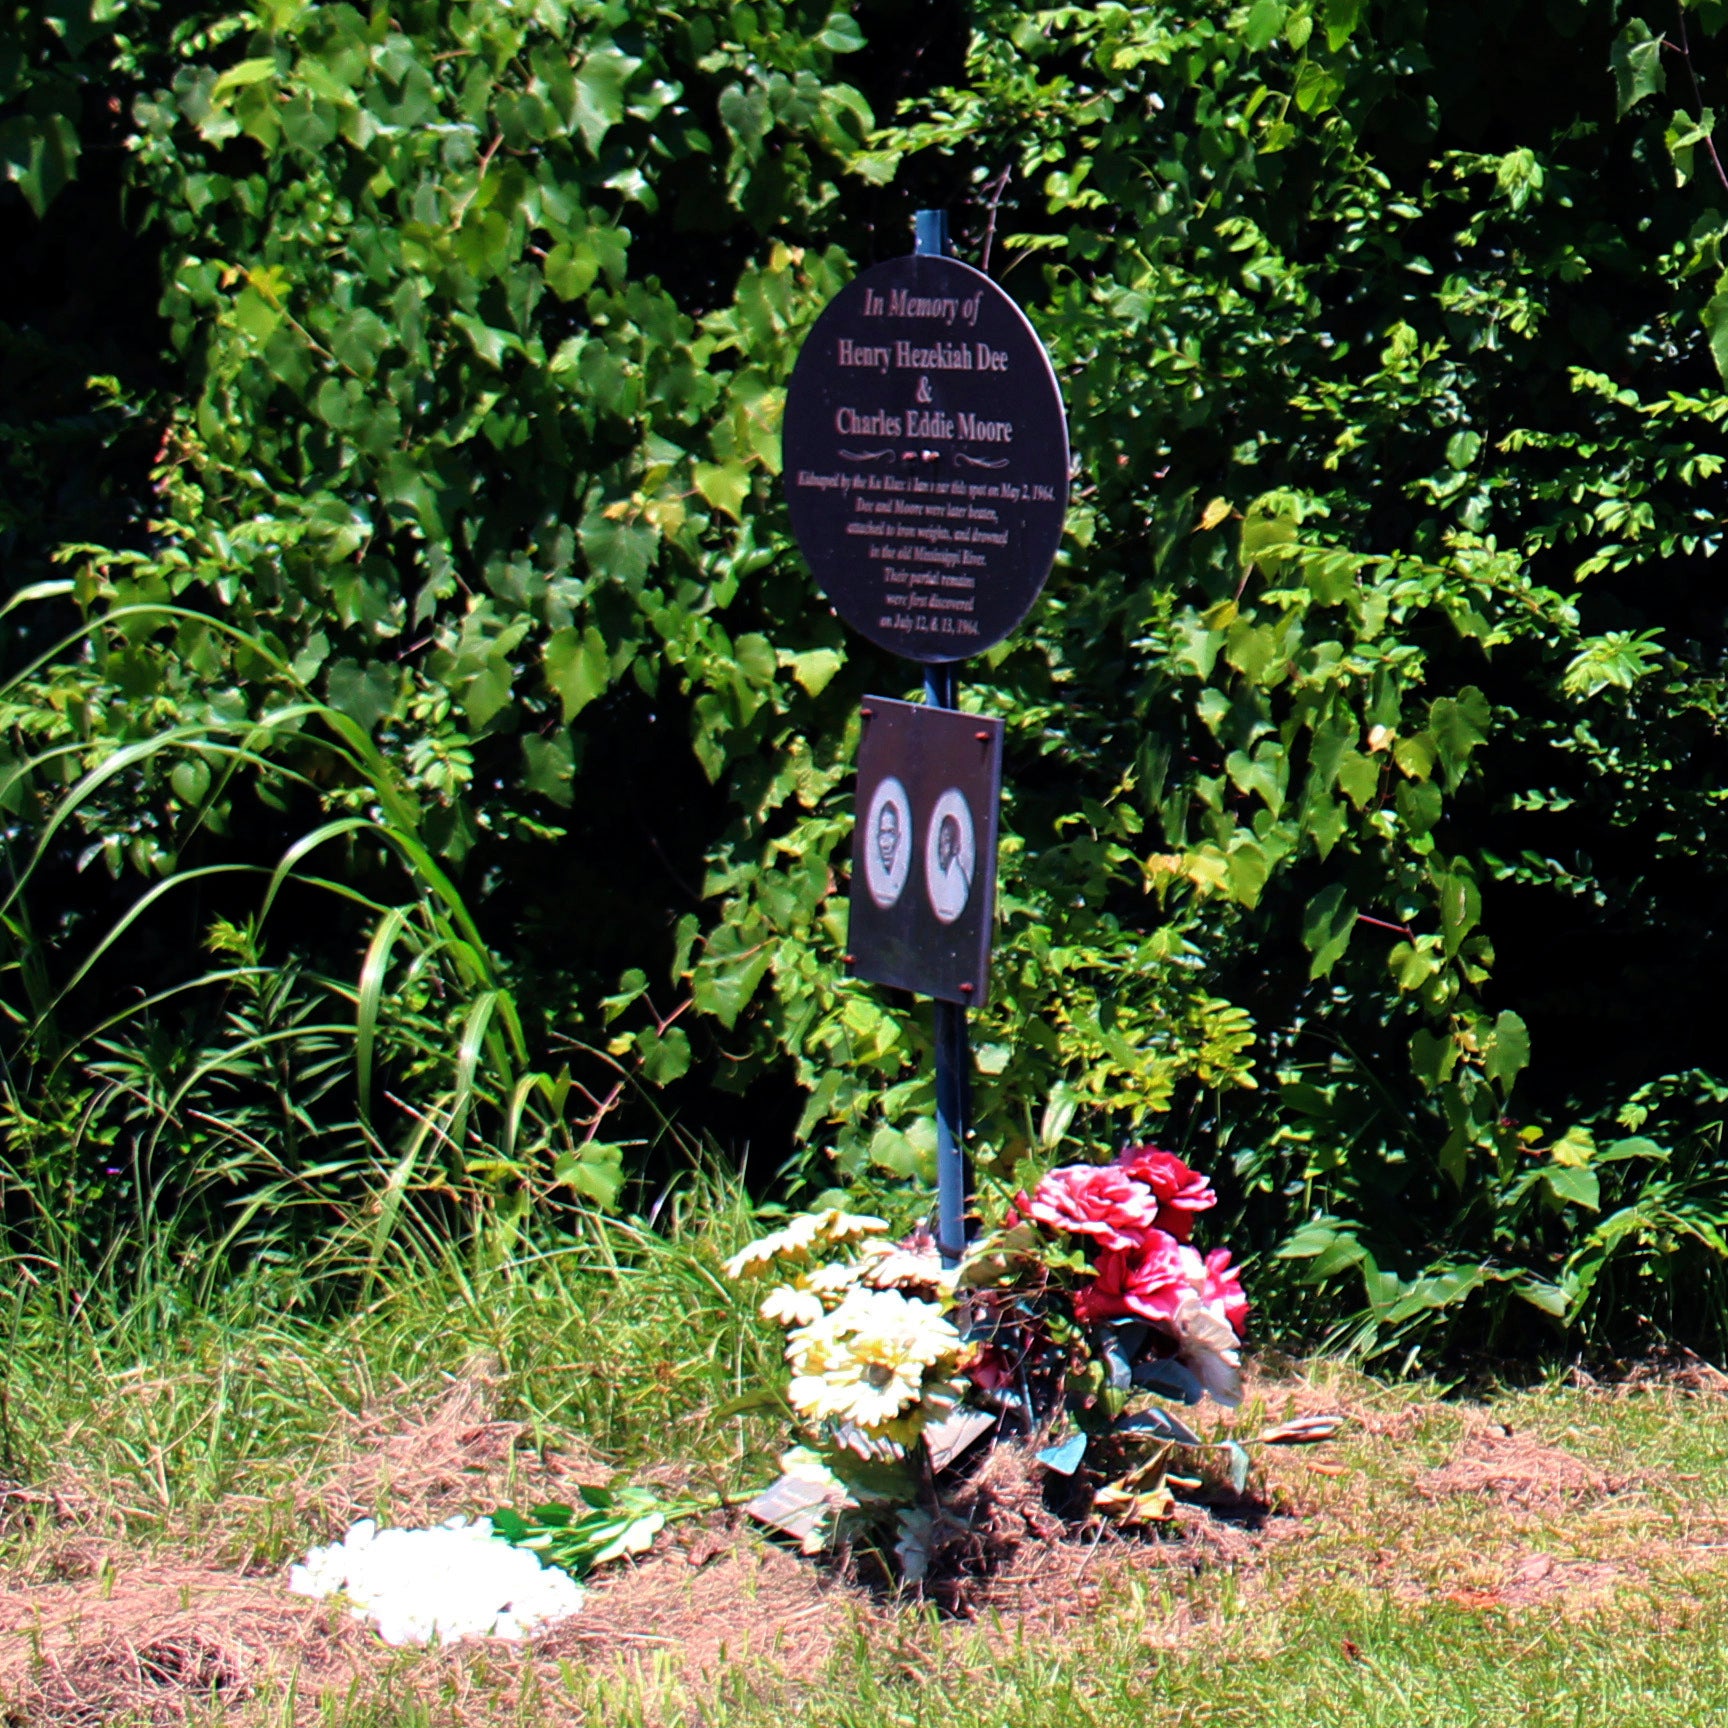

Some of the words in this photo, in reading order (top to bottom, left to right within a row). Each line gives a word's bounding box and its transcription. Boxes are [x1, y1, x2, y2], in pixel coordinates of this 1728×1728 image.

[863, 288, 884, 316] In
[888, 288, 958, 325] Memory
[962, 290, 983, 326] of
[838, 339, 891, 374] Henry
[896, 340, 972, 369] Hezekiah
[976, 344, 1008, 371] Dee
[915, 376, 933, 403] &
[836, 408, 901, 437] Charles
[906, 411, 955, 439] Eddie
[958, 413, 1013, 442] Moore
[1001, 483, 1020, 503] May
